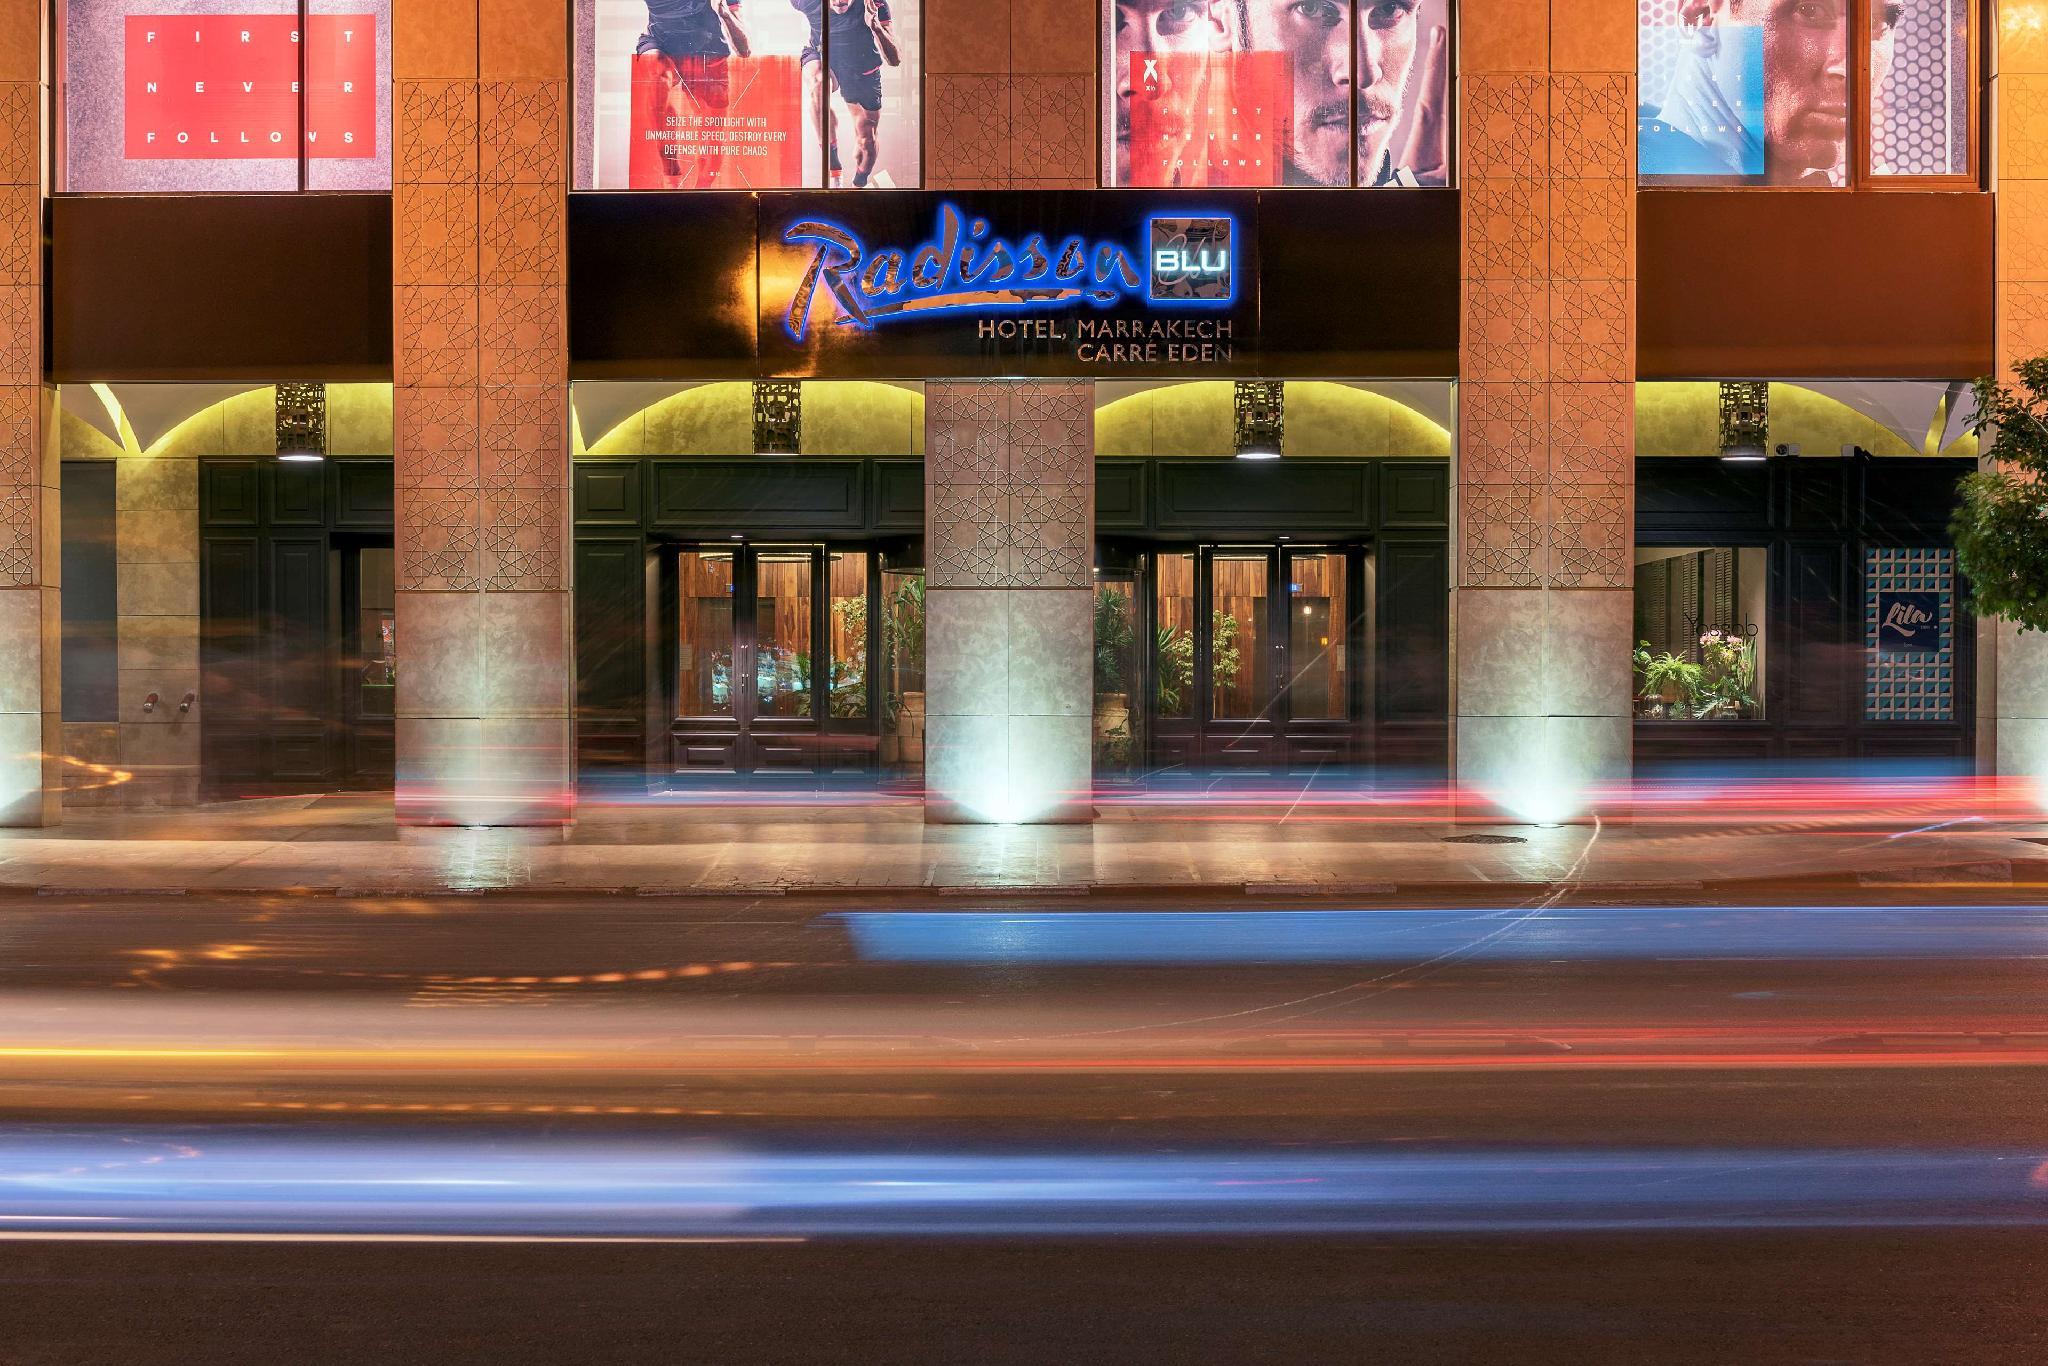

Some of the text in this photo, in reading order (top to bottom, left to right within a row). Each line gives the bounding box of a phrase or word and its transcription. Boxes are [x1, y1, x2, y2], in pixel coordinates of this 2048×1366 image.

[147, 30, 353, 43] FIRST
[147, 81, 353, 93] NEVER
[1163, 108, 1261, 116] FIRST
[666, 116, 767, 128] SEIZE THE SPOTLIGHT WITH
[645, 130, 787, 142] UNMATCHABLE SPEED, DESTROY EVERY
[1163, 133, 1261, 141] NEVER
[664, 144, 768, 156] DEFENSE WITH PURE CHAOS
[1163, 159, 1261, 167] FOLLOWS
[784, 203, 1227, 338] Radisson BLU
[978, 319, 1232, 341] HOTEL, MARRAKECH
[1077, 340, 1233, 362] CARRÉ EDEN
[1881, 602, 1933, 637] Lila
